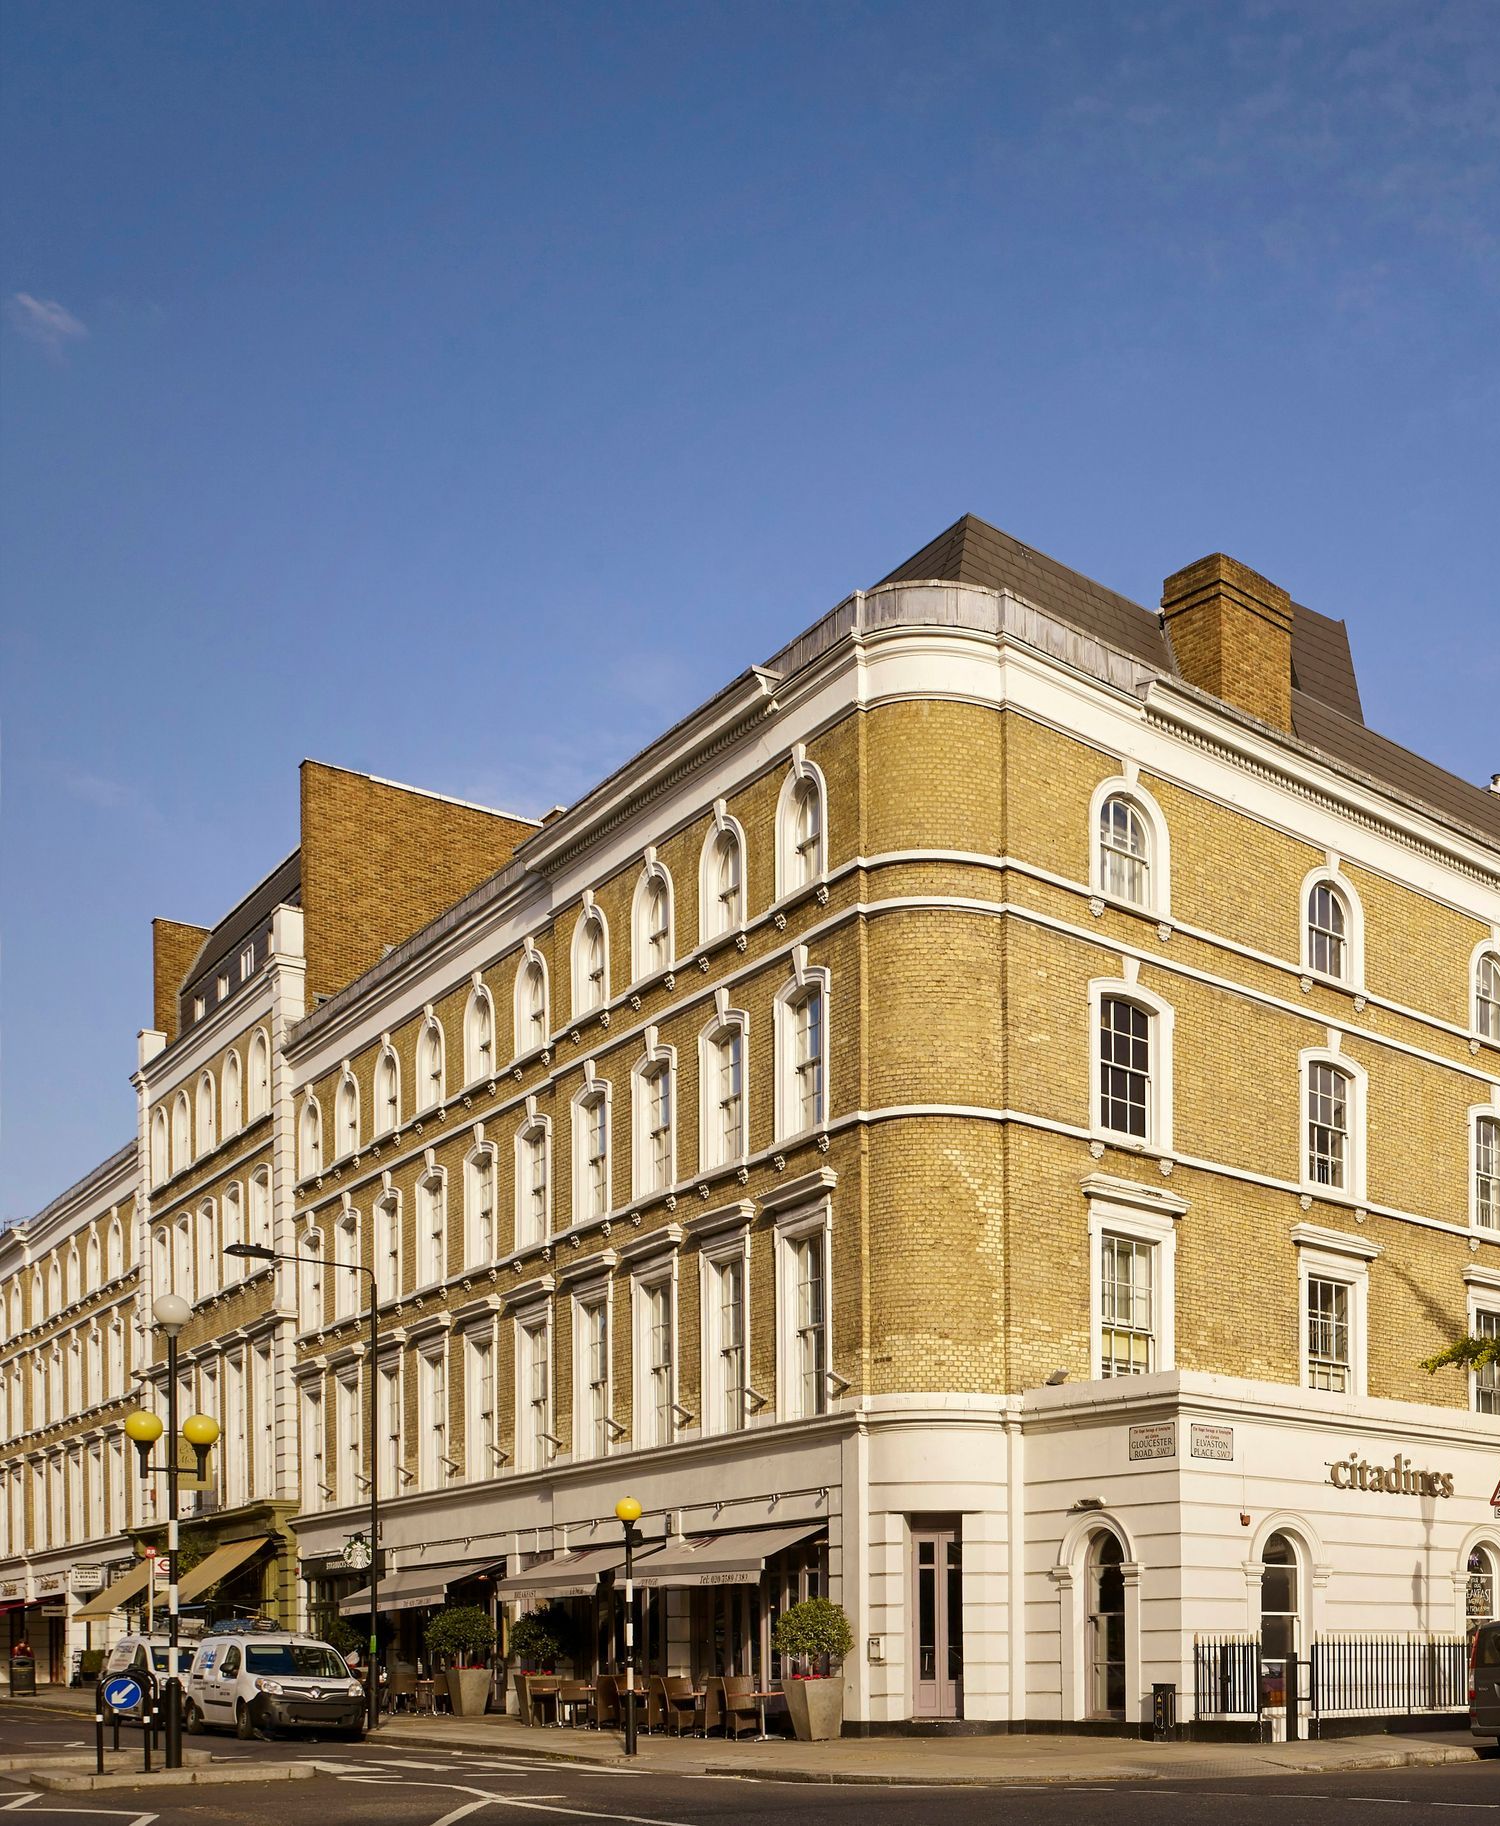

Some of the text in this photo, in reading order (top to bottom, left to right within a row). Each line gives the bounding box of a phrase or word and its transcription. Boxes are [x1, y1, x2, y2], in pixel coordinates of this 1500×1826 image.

[1131, 1437, 1173, 1449] GLOUCESTER
[1196, 1438, 1228, 1449] ELVASTON
[1330, 1452, 1455, 1498] citadines
